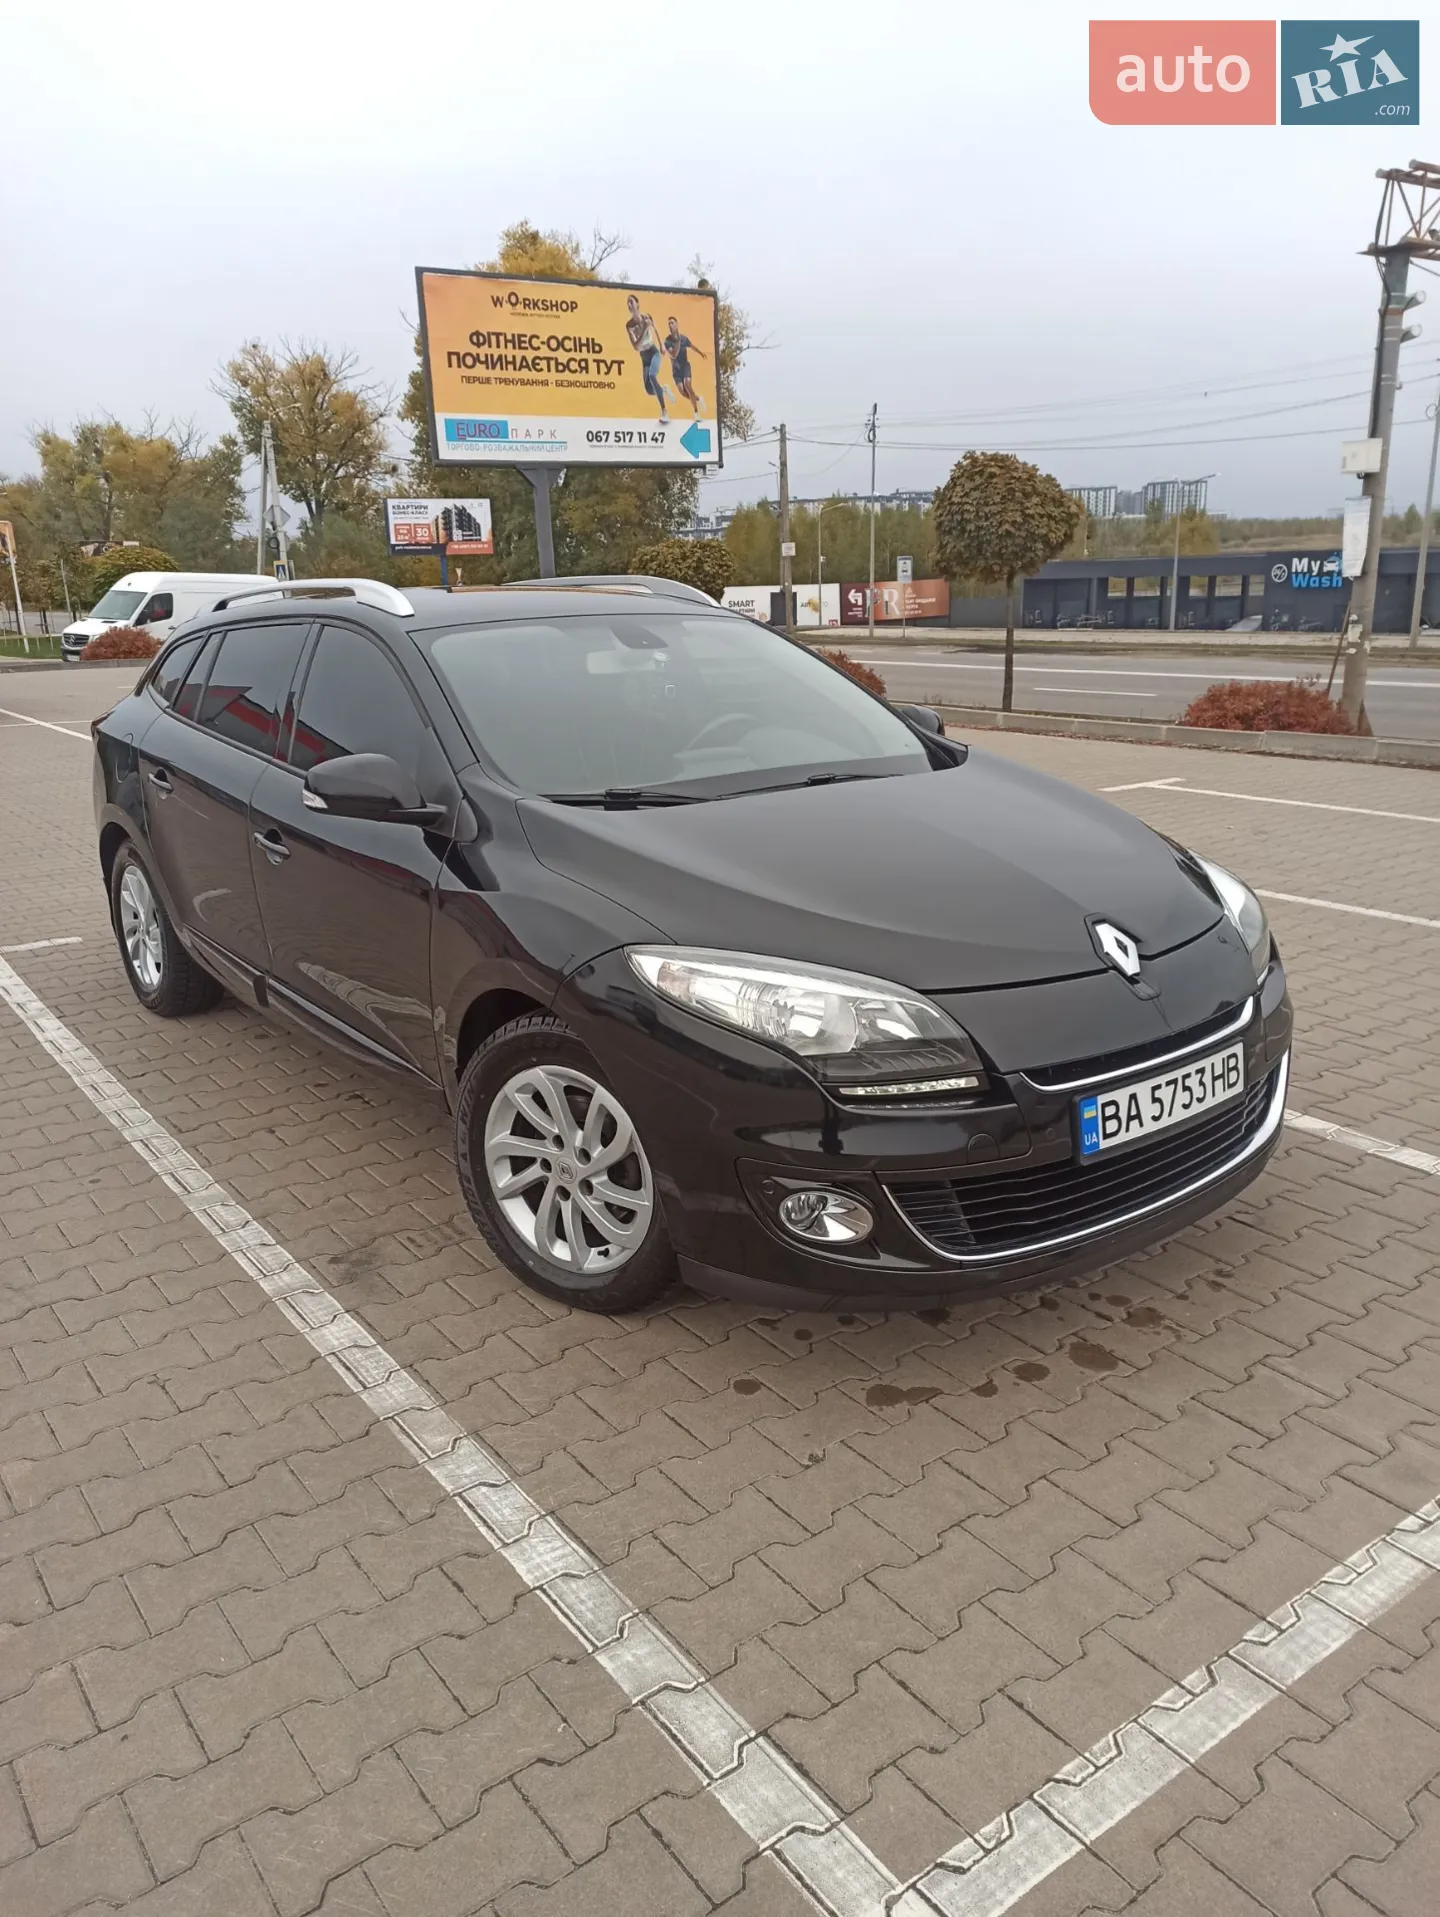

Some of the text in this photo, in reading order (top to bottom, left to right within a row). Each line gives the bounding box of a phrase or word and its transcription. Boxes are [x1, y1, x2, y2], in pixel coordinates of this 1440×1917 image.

[468, 330, 603, 354] ФІТНЕС-ОСІНЬ
[447, 351, 625, 376] ПОЧИНАЄТЬСЯ ТУТ
[461, 376, 491, 385] ПЕРШЕ
[493, 377, 549, 388] ТРЕНУВАННЯ
[555, 379, 616, 390] БЕЗКОШТОВНО
[456, 422, 500, 440] EURO
[587, 430, 665, 443] 067 517 11 47
[1292, 558, 1321, 575] My
[1292, 572, 1342, 588] Wash
[1101, 1092, 1144, 1141] BA
[1151, 1066, 1207, 1122] 5753
[1084, 1133, 1098, 1145] UA
